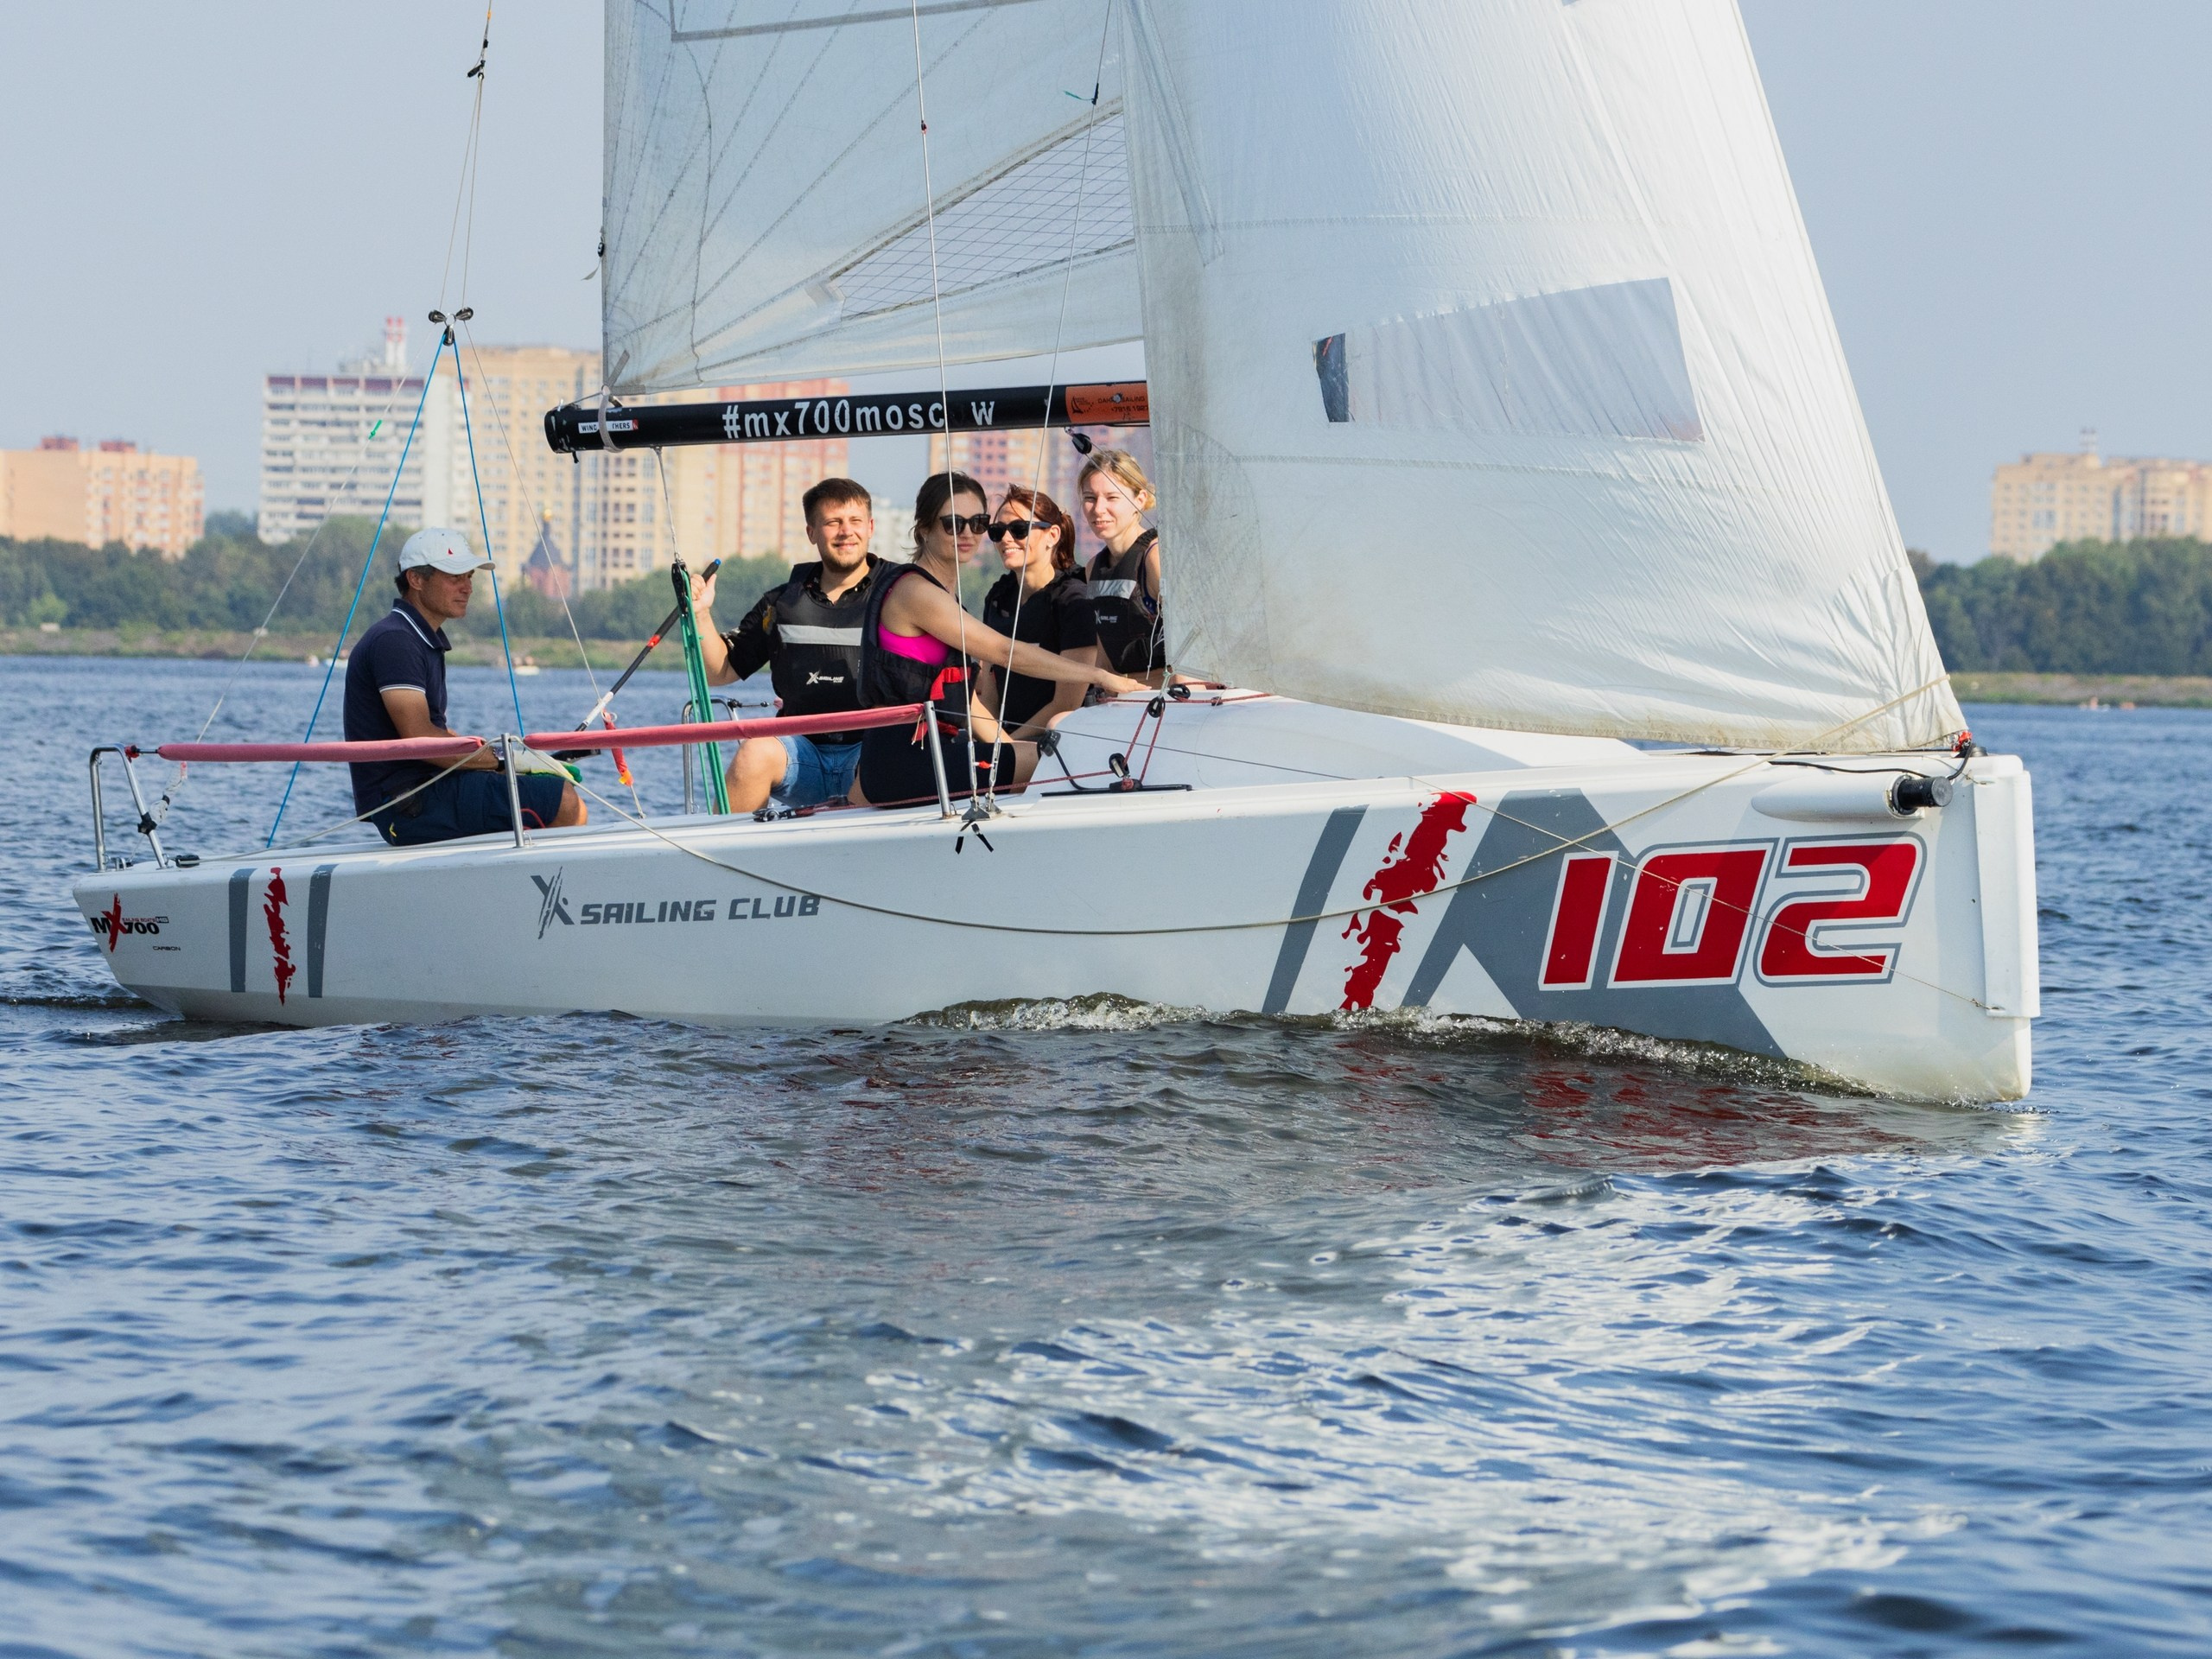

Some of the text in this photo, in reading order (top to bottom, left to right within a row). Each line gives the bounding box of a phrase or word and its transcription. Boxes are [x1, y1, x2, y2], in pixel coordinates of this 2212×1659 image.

[581, 899, 716, 925] SAILING
[728, 895, 821, 920] CLUB
[1539, 832, 1927, 991] 102
